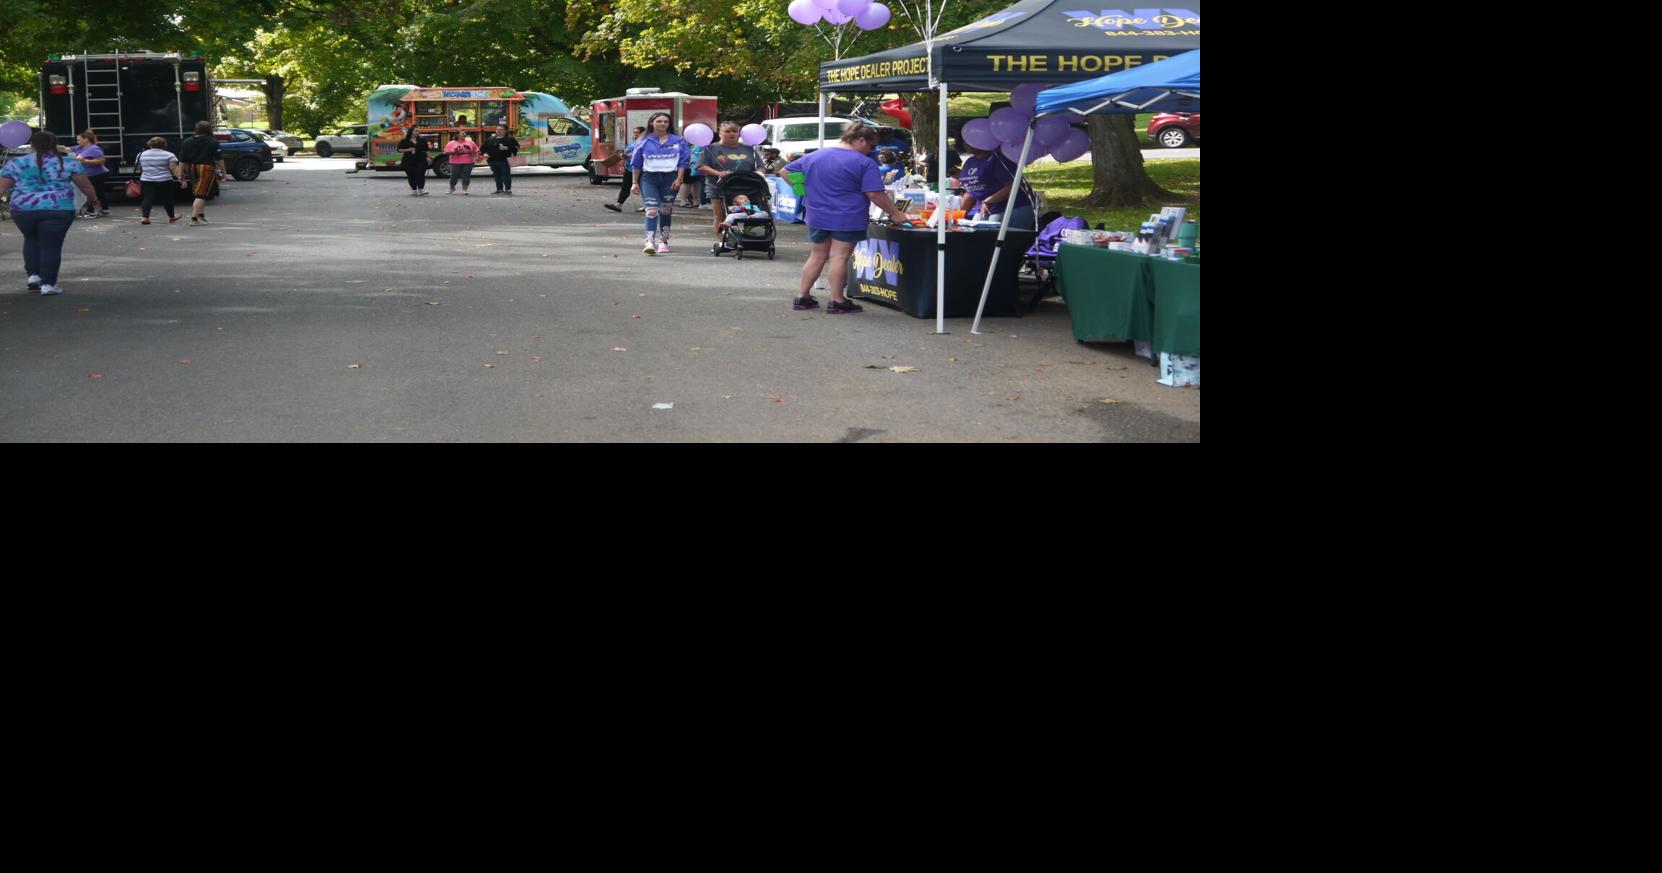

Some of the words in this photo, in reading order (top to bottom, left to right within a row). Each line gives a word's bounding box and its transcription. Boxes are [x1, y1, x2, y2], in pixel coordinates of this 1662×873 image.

[1066, 14, 1148, 28] Hope
[827, 70, 840, 83] THE
[841, 66, 860, 81] HOPE
[861, 61, 891, 79] DEALER
[987, 55, 1048, 72] THE
[1057, 55, 1142, 72] HOPE
[873, 252, 904, 279] Dealer
